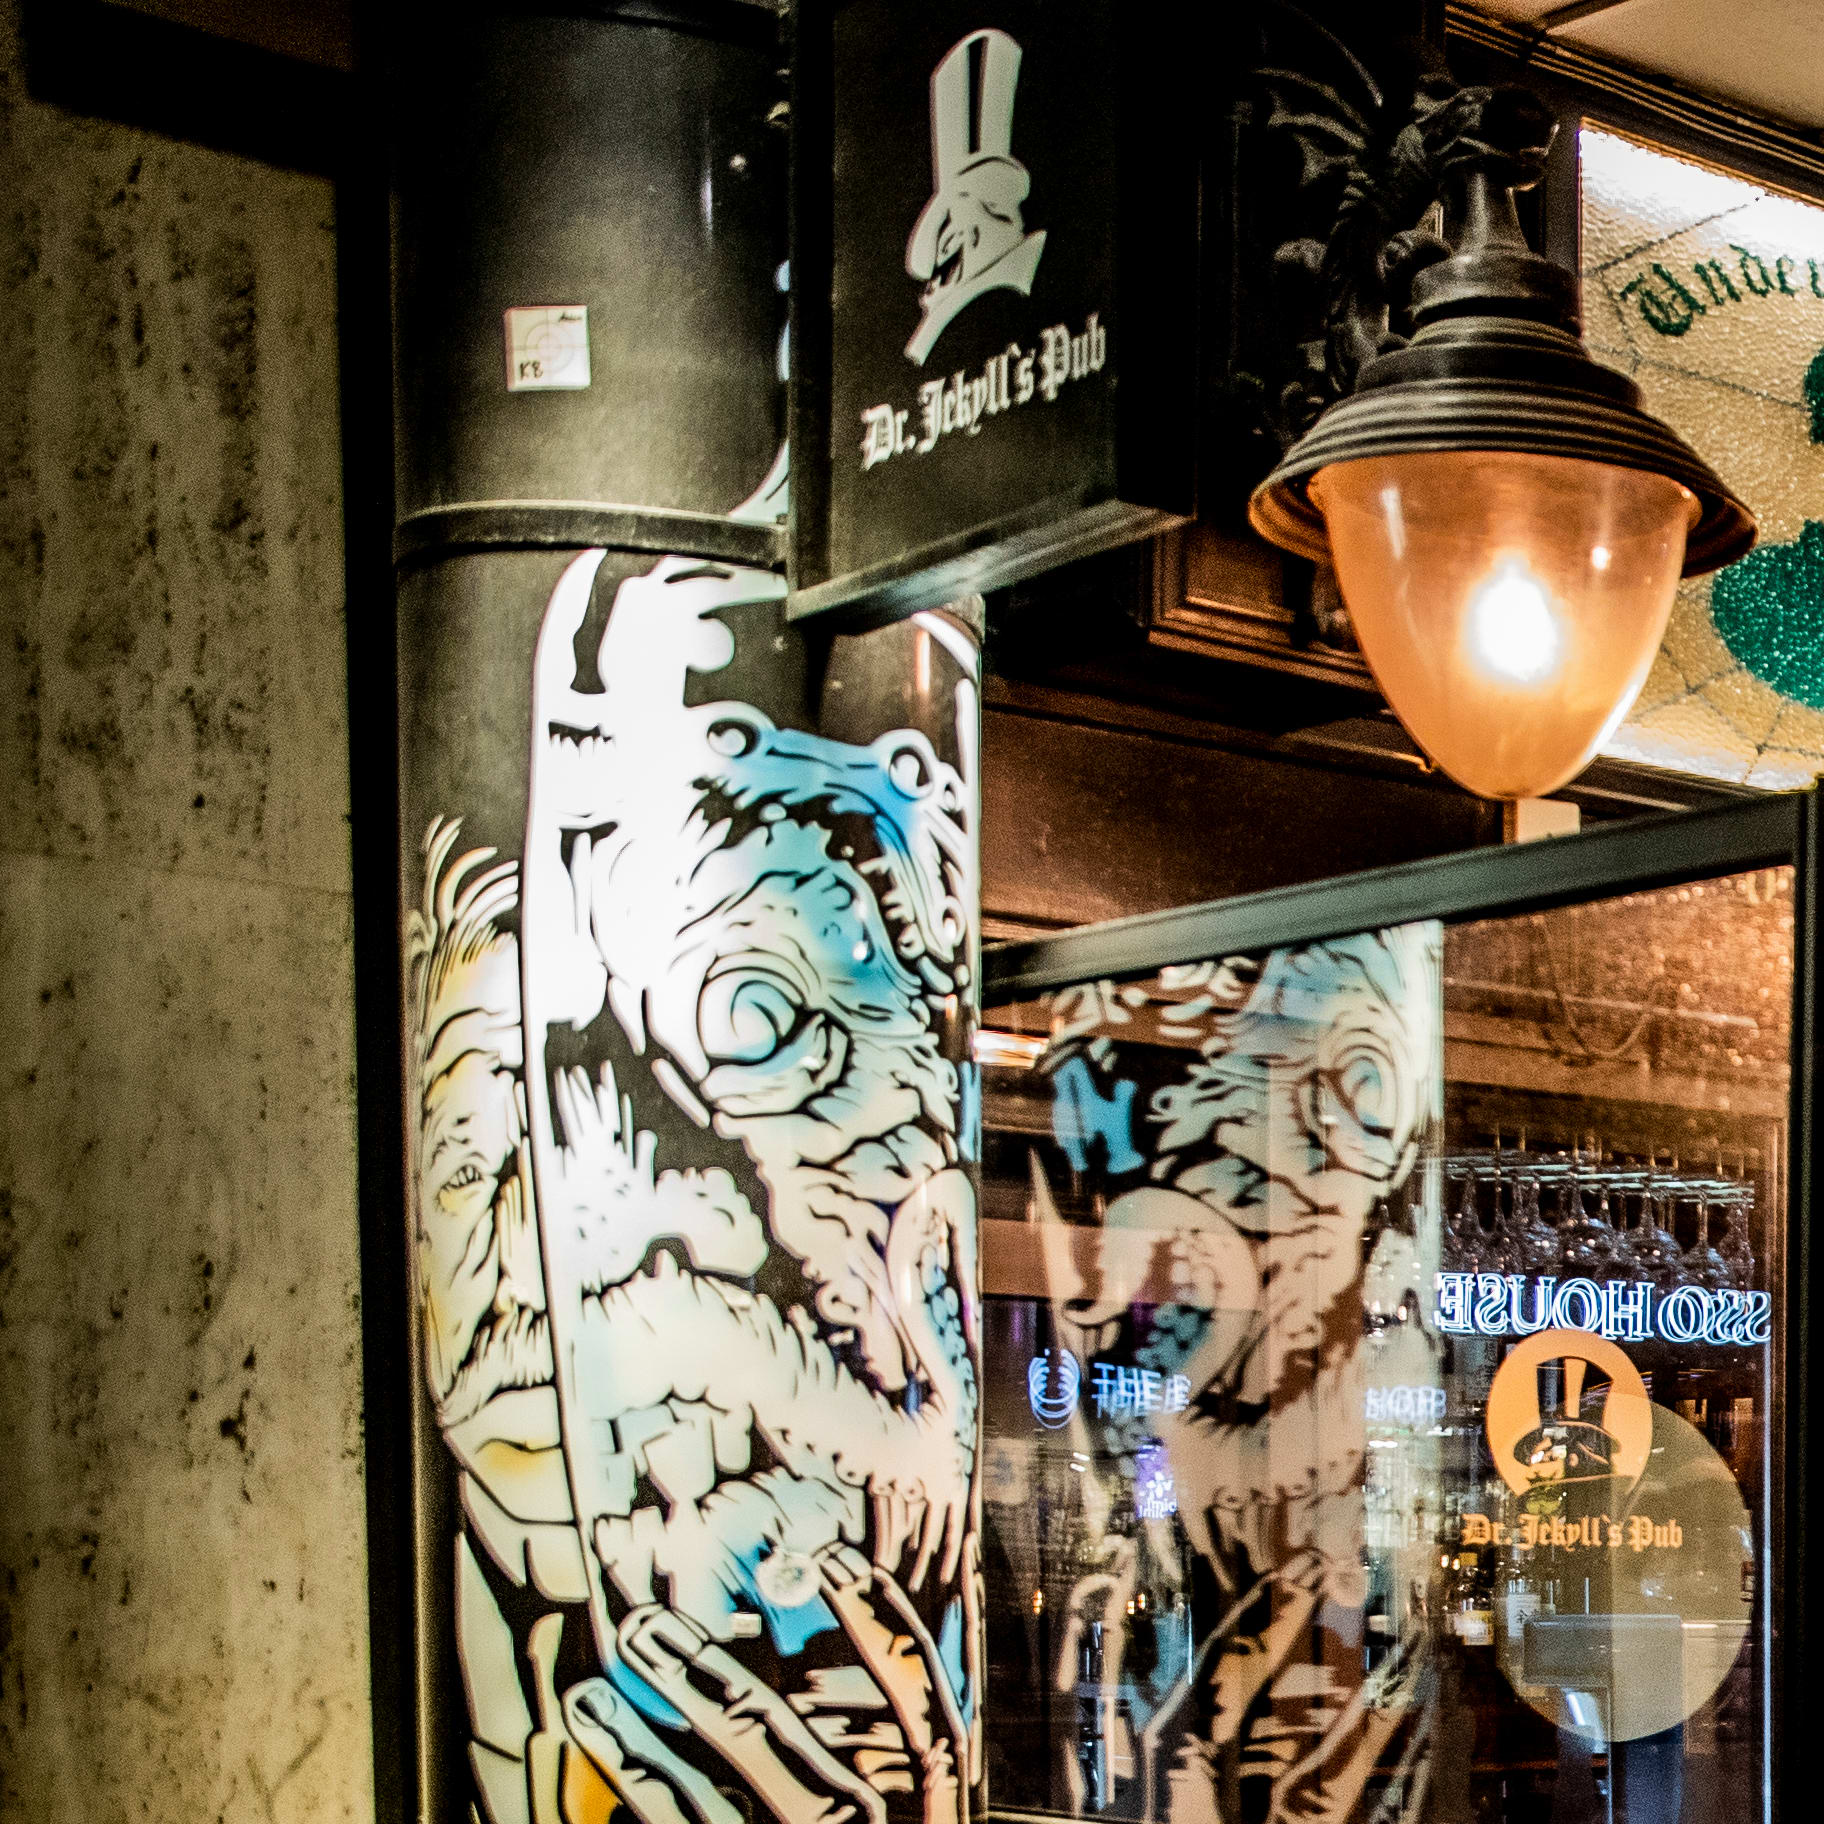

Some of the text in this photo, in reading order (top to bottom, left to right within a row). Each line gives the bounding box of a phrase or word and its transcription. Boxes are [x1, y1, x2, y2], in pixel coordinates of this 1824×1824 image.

[860, 403, 916, 471] Dr.
[1039, 312, 1106, 401] Pub
[1461, 1513, 1512, 1546] Dr.
[1628, 1514, 1684, 1552] Pub
